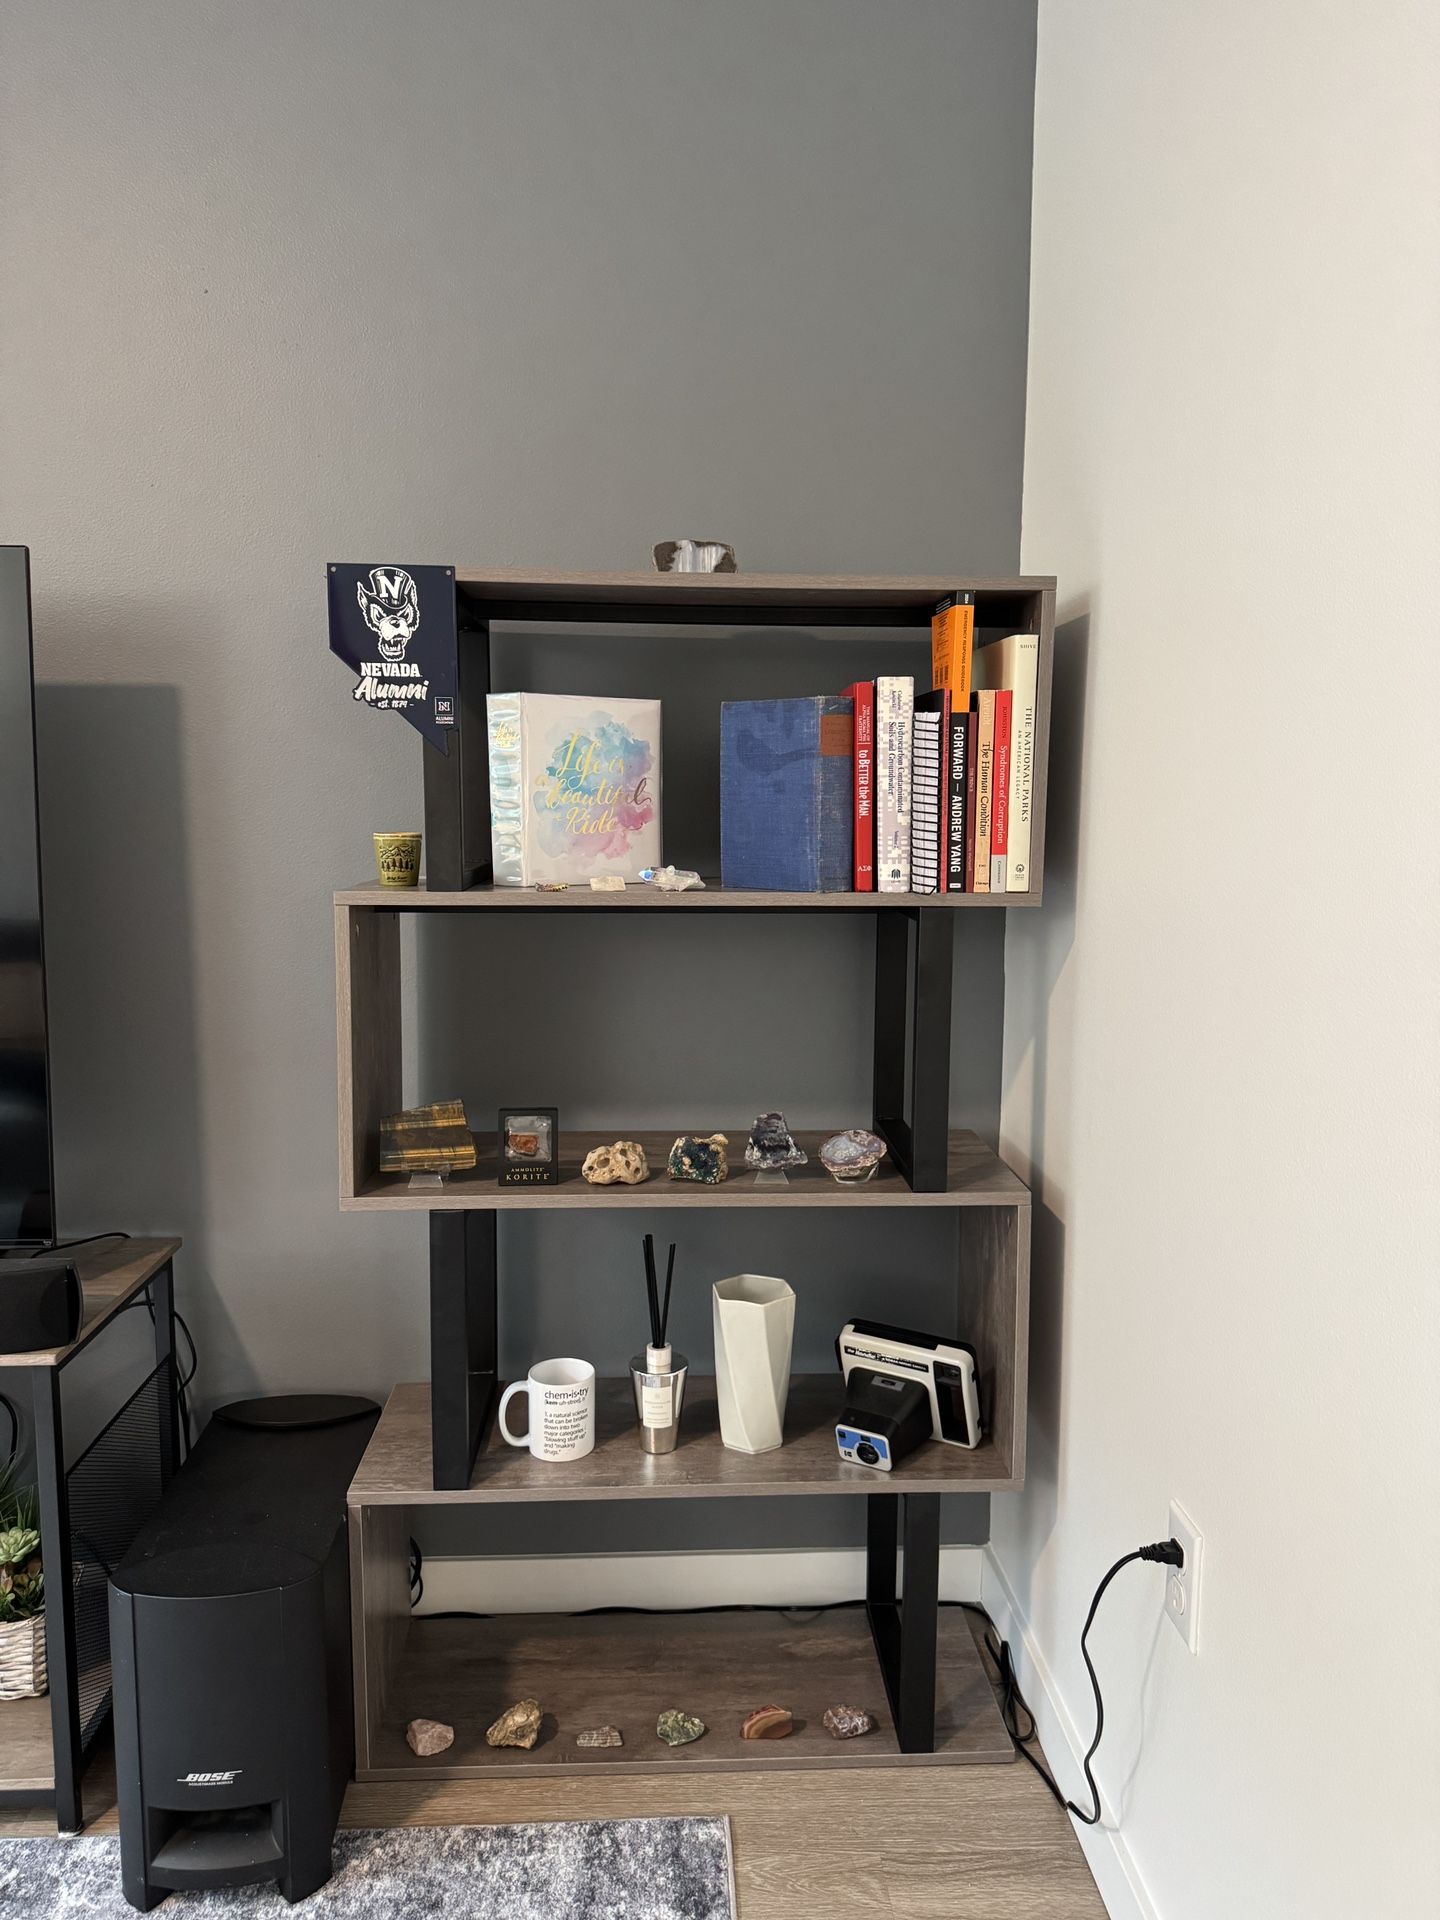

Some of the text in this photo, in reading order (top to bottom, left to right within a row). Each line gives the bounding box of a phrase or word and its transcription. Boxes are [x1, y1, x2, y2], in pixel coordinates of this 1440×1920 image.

[378, 575, 404, 600] N
[360, 662, 421, 678] NEVADA
[354, 676, 430, 701] Alumni
[888, 722, 896, 737] Soils
[896, 722, 905, 766] Hydrocarbon
[952, 726, 964, 780] FORWARD
[556, 728, 602, 789] Life
[608, 755, 625, 774] is
[859, 760, 869, 785] BETTER
[1022, 731, 1032, 786] NATIONAL
[859, 787, 869, 799] the
[980, 742, 993, 836] The Human Condition
[996, 745, 1008, 844] Syndromes of Corruption
[859, 801, 869, 819] MAN.
[951, 795, 962, 841] ANDREW
[1022, 789, 1030, 822] PARKS
[564, 806, 620, 835] Ride
[950, 844, 961, 872] YANG
[180, 1770, 240, 1782] BOSE
